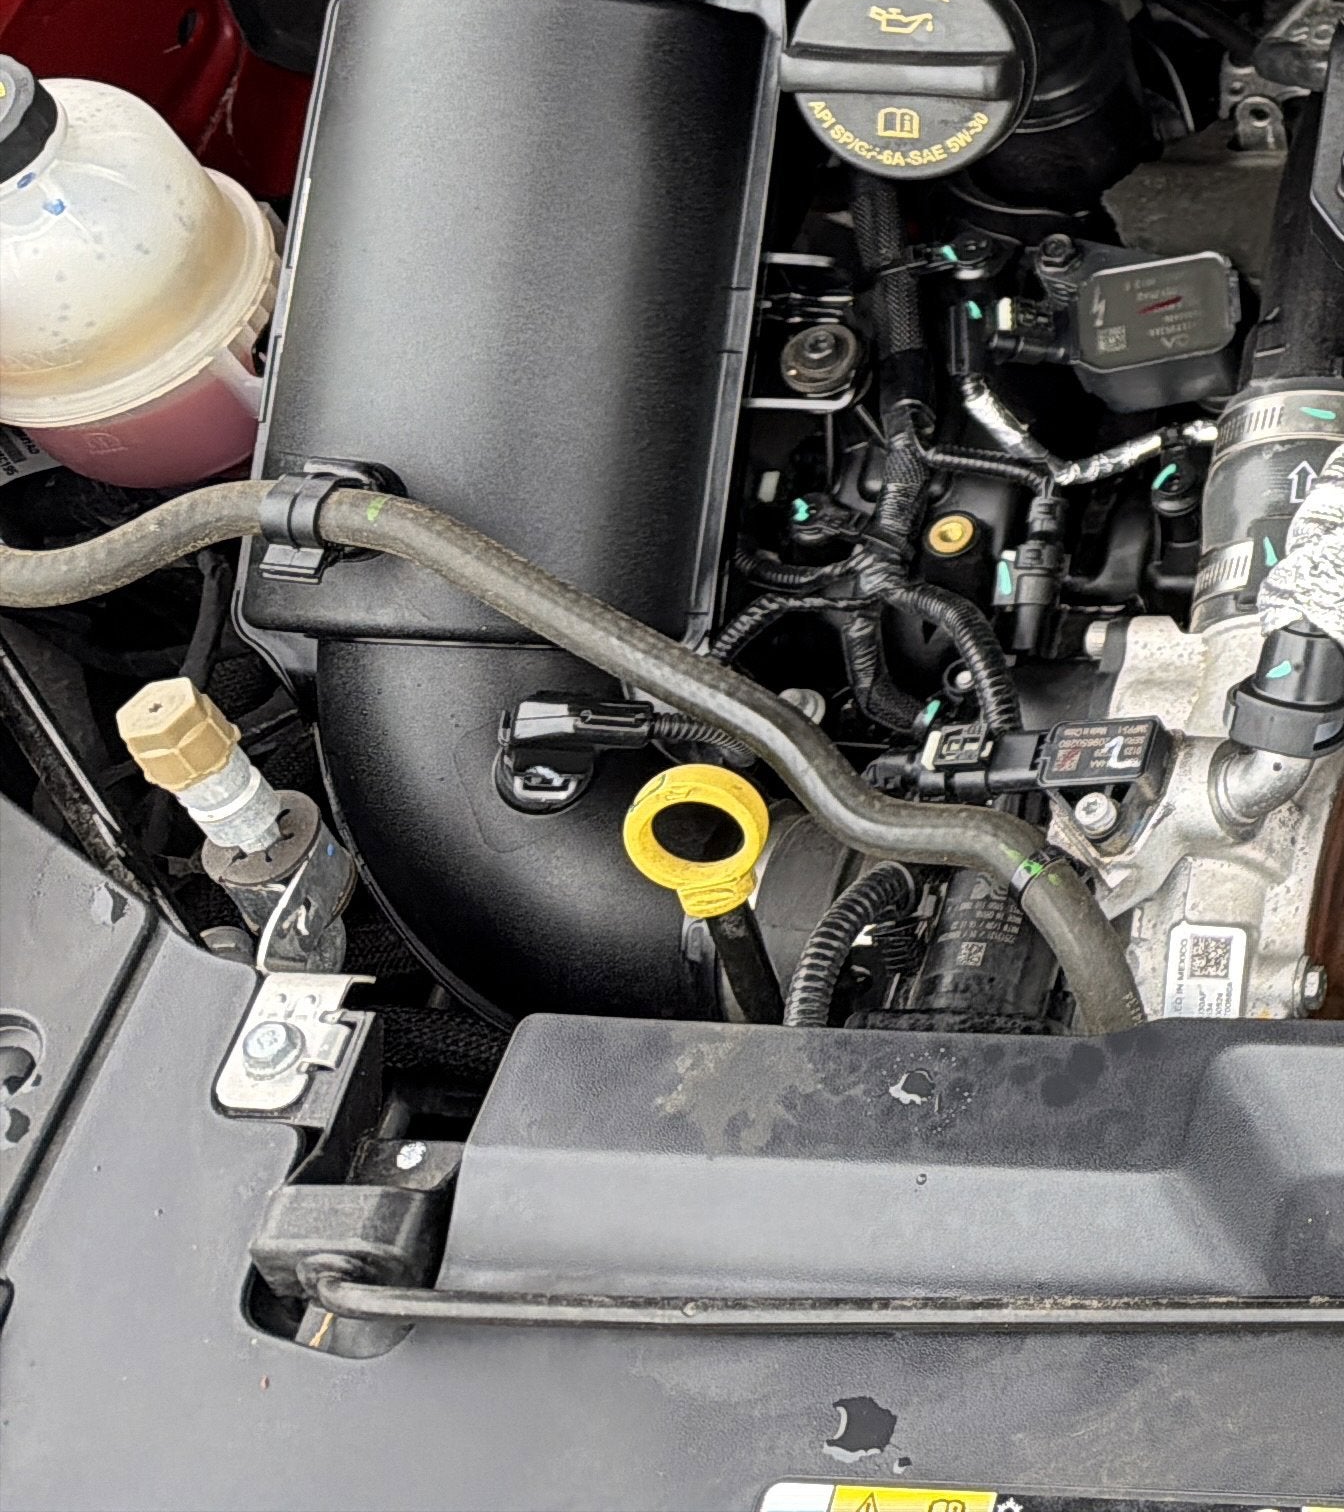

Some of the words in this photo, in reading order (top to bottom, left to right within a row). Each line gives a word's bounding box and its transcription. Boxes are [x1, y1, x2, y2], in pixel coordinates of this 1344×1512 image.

[807, 101, 836, 129] API
[945, 111, 990, 154] 5W-30
[1177, 938, 1188, 981] MEXICO
